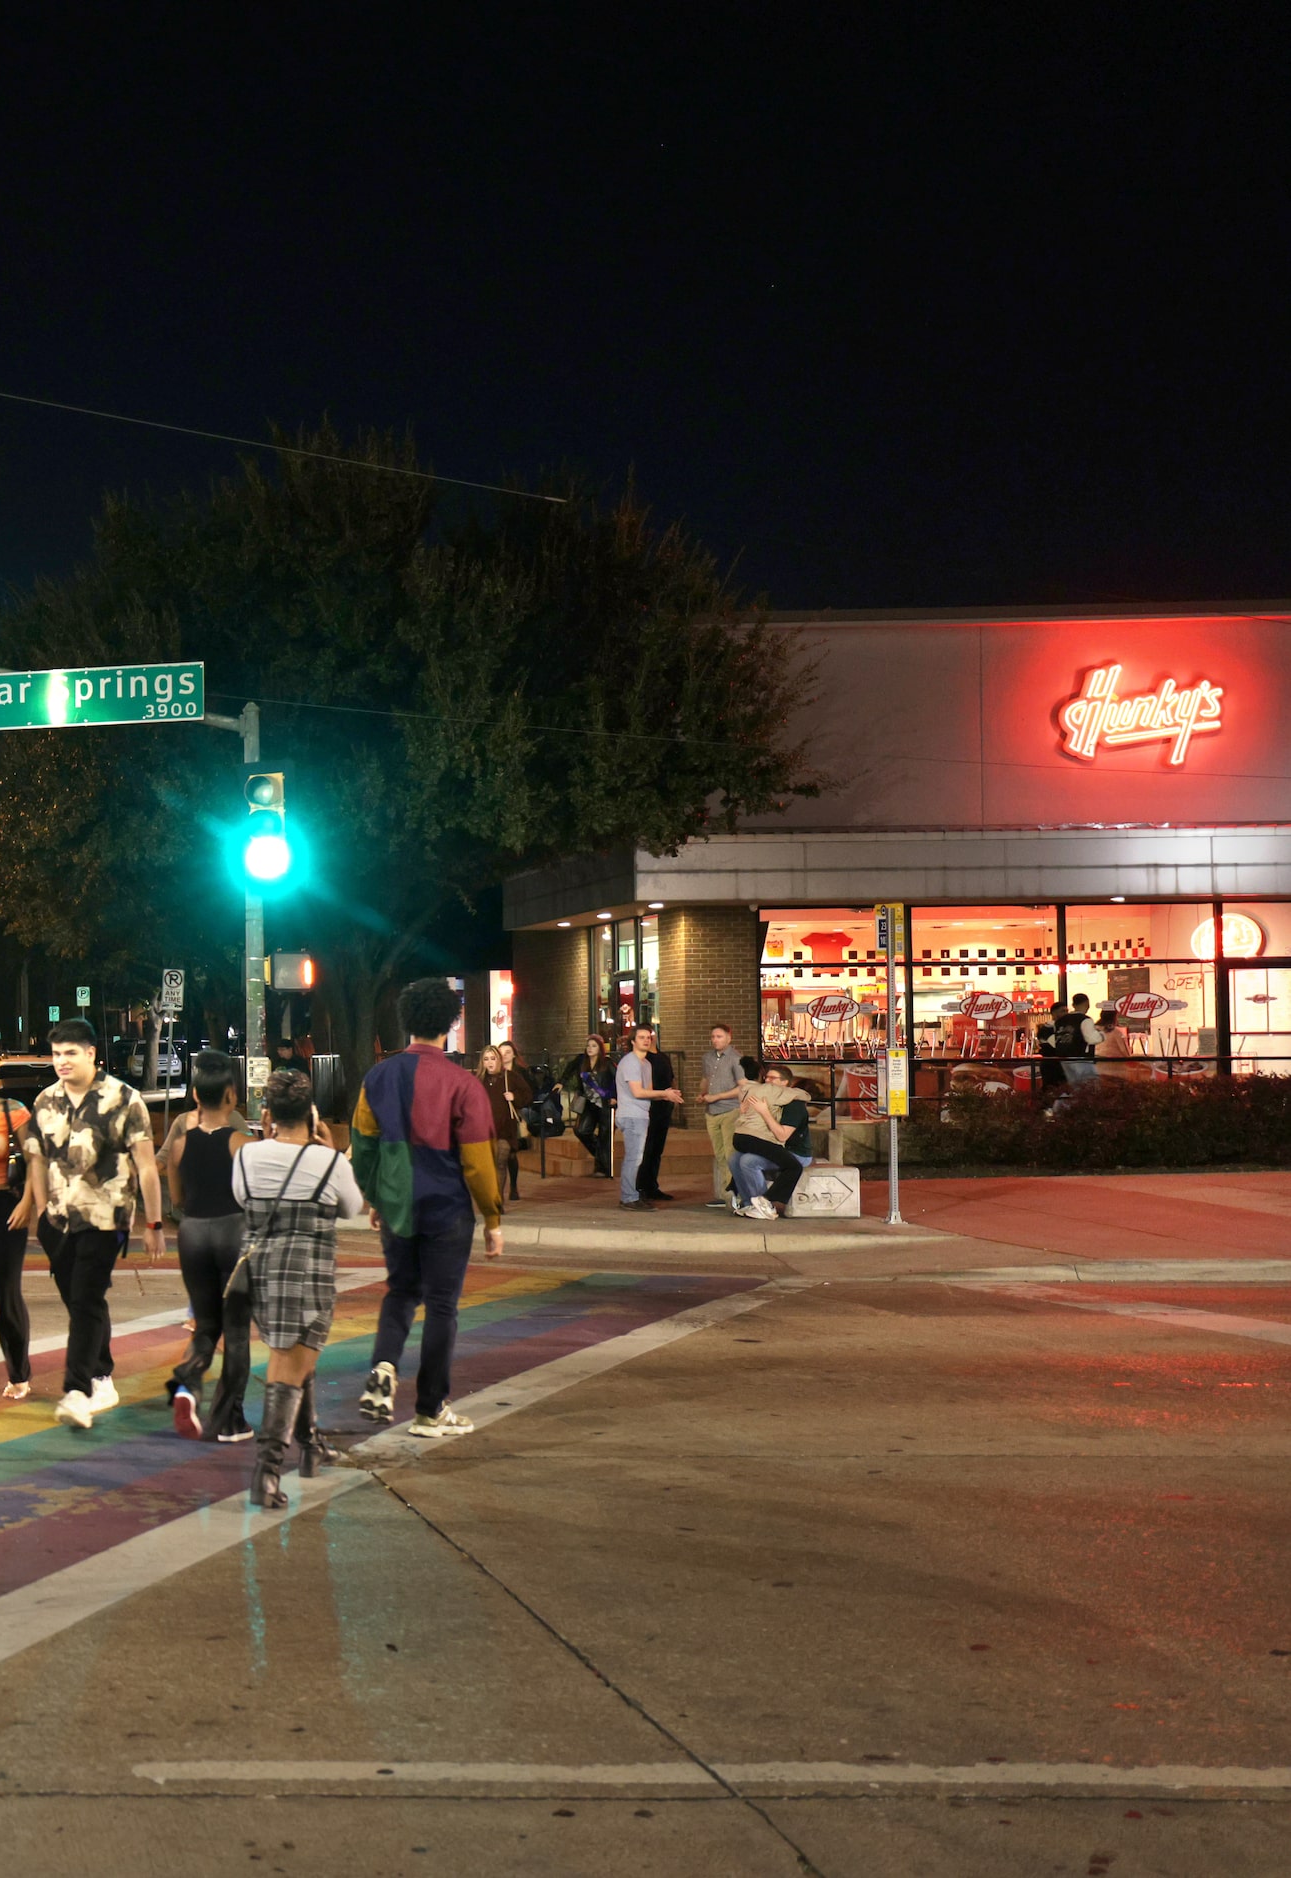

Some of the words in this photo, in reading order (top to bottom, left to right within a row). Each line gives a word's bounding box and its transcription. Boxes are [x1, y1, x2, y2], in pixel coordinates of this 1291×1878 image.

[145, 701, 197, 718] 3900
[1064, 663, 1224, 765] Hunky's
[811, 996, 855, 1021] Hunky's
[964, 994, 1009, 1020] Hunky's
[1118, 992, 1164, 1018] Hunky's
[796, 1192, 845, 1205] DART
